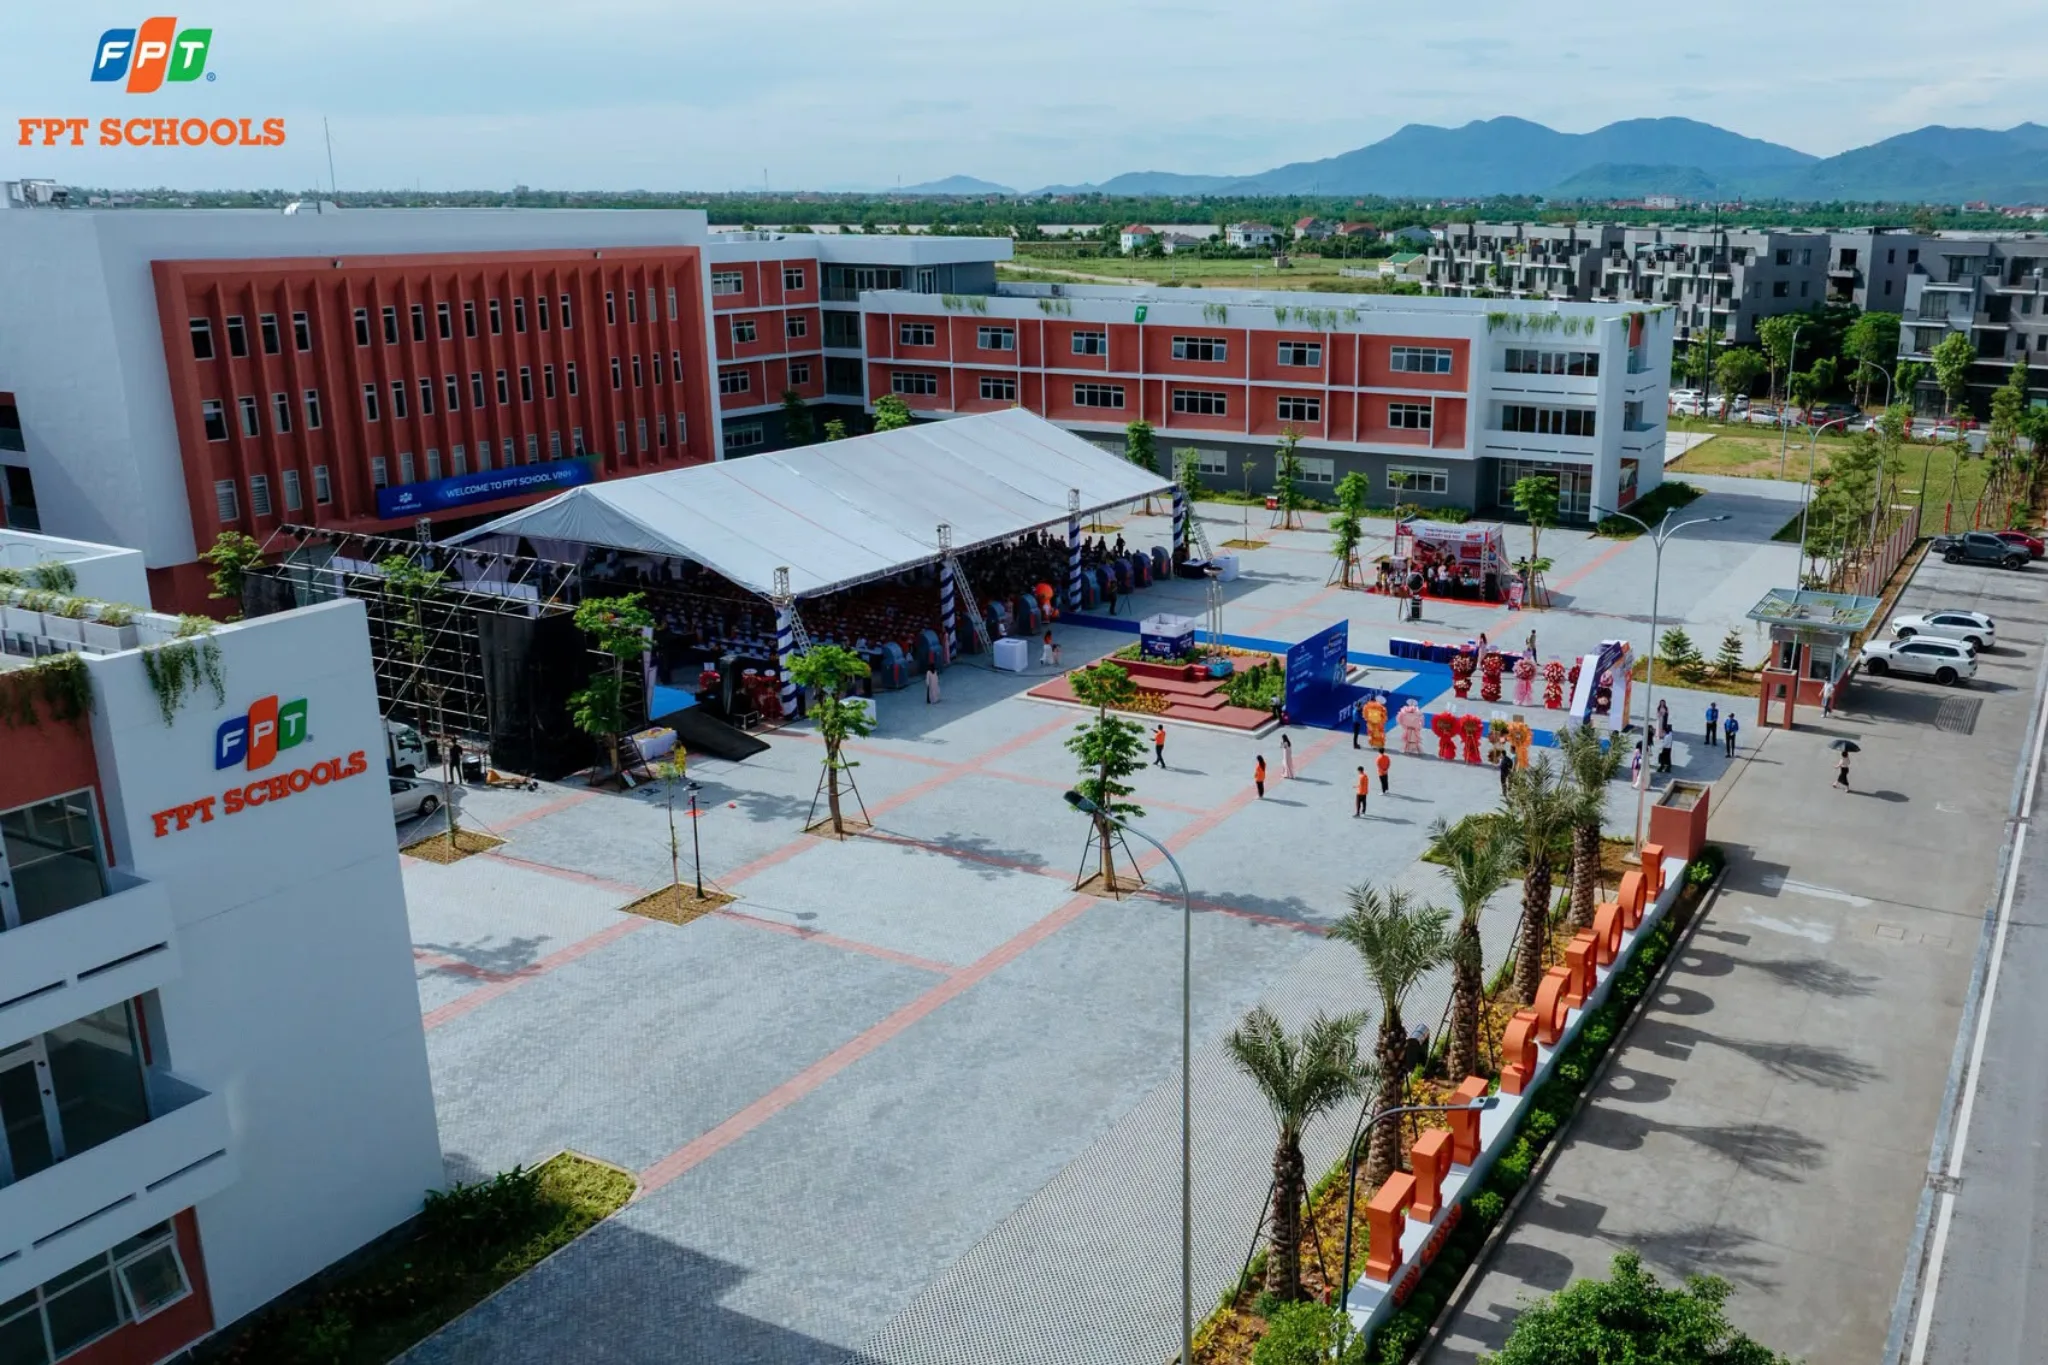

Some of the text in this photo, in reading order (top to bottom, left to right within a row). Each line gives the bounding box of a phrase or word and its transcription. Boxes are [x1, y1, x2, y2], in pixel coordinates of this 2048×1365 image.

[446, 483, 489, 498] WELCOME
[490, 481, 501, 490] TO
[502, 478, 518, 488] FPT
[519, 473, 552, 485] SCHOOL
[222, 712, 304, 758] FPT
[151, 750, 368, 838] FPT SCHOOLS
